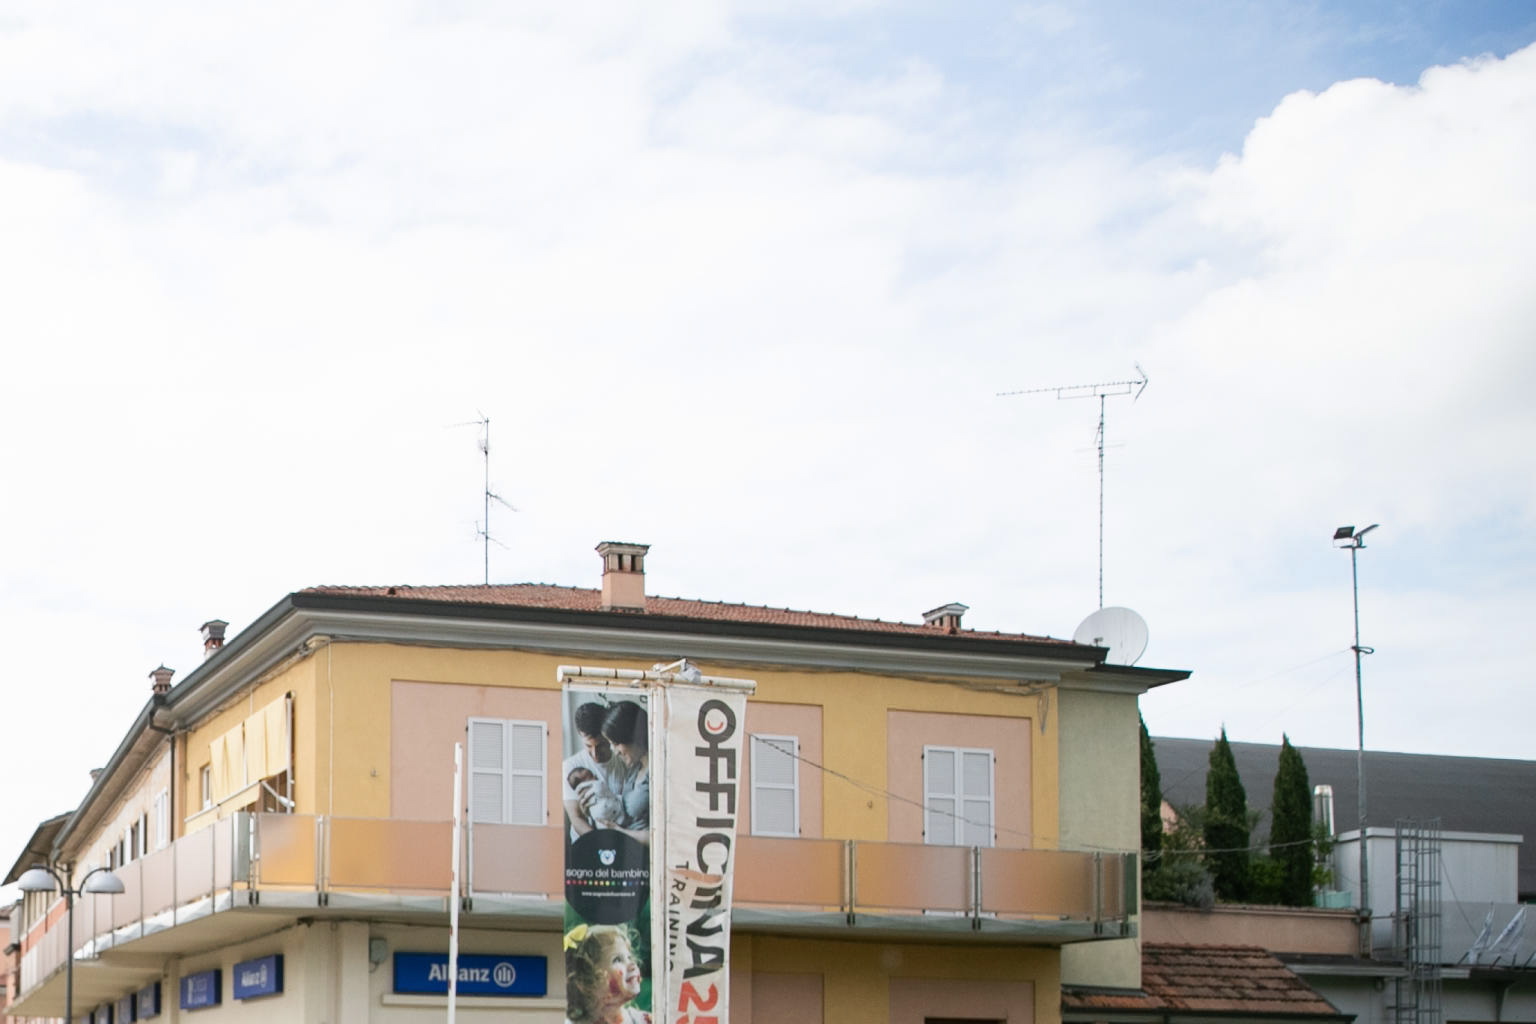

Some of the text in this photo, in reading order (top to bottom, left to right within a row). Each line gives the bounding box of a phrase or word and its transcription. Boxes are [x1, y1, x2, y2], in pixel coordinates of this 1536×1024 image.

[566, 868, 649, 879] sogno del bambino
[428, 963, 490, 982] Alanz
